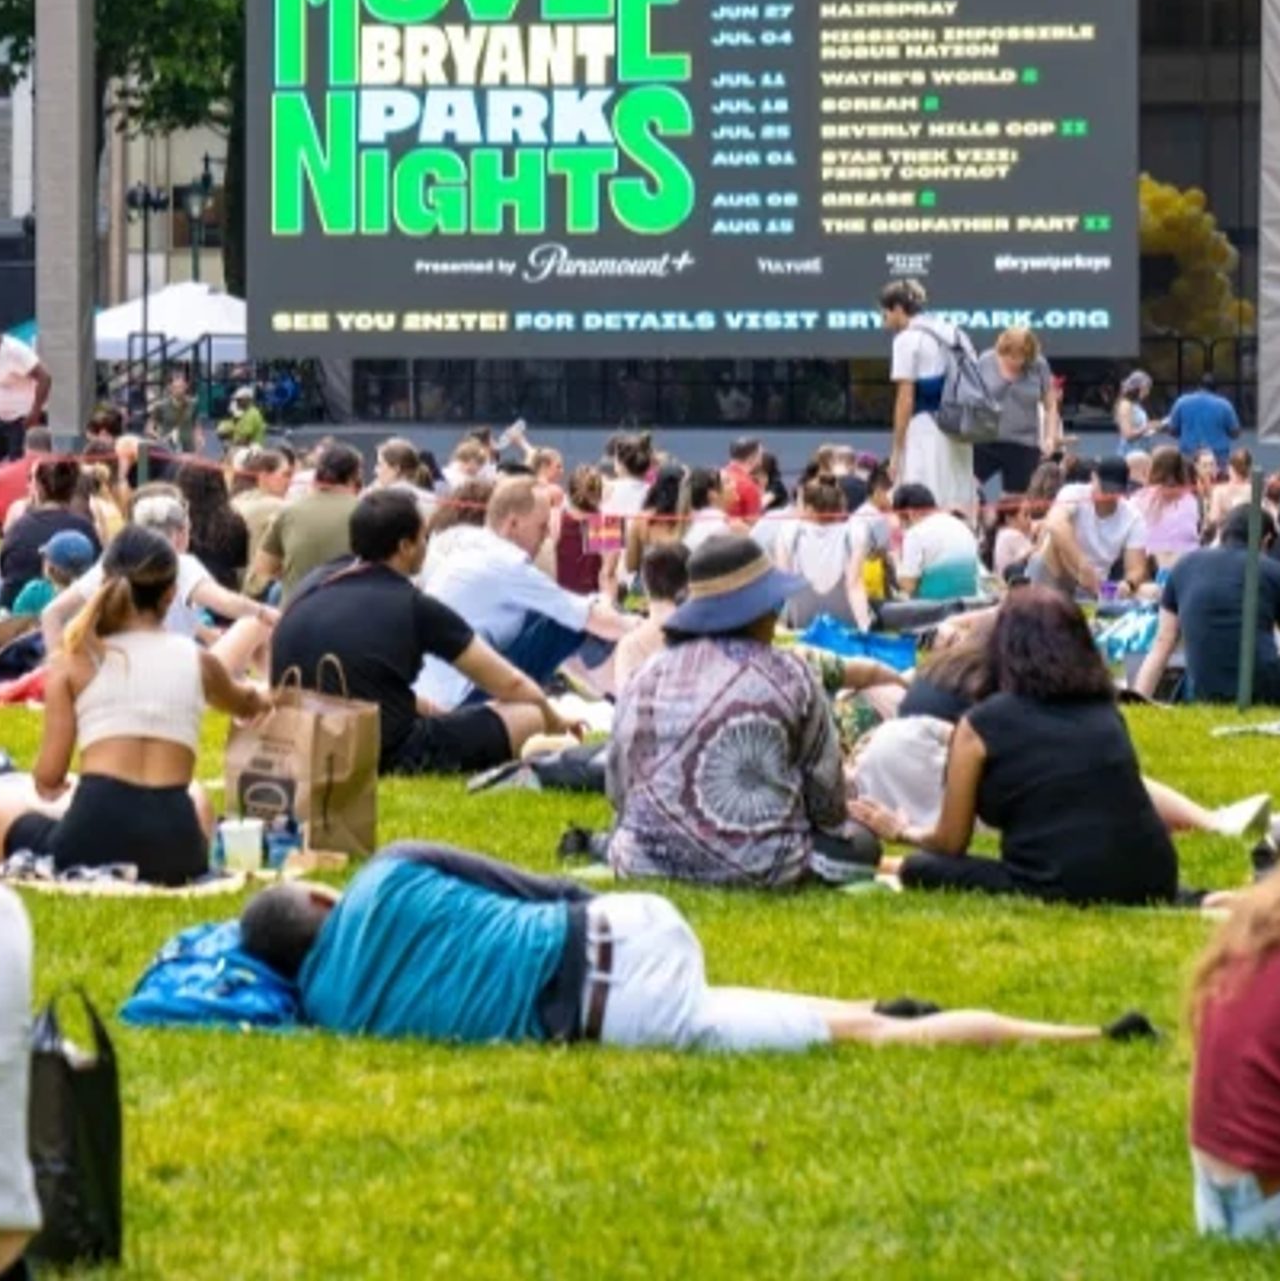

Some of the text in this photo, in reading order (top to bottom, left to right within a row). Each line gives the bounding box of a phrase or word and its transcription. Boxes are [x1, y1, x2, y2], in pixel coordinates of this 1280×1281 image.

[711, 4, 759, 19] JUN
[821, 1, 958, 18] HAIRSPRAY
[711, 31, 756, 47] JUL
[943, 25, 1096, 41] IMPOSSIBLE
[360, 24, 615, 86] BRYANT
[905, 44, 1000, 58] NATION
[711, 73, 756, 88] JUL
[930, 68, 1018, 84] WORLD
[711, 99, 756, 114] JUL
[821, 97, 919, 113] SCREAM
[359, 89, 613, 143] PARK
[711, 125, 756, 140] JUL
[821, 123, 922, 139] BEVERLY
[928, 122, 1000, 137] HILLS
[1004, 121, 1057, 137] COP
[271, 85, 695, 235] NIGHTS
[711, 151, 761, 166] AUG
[821, 150, 882, 165] STAR
[887, 149, 948, 164] TREK
[821, 164, 1010, 181] FIRST CONTACT
[711, 193, 761, 208] AUG
[821, 191, 916, 207] GREASE
[711, 219, 761, 234] AUG
[821, 218, 866, 233] THE
[872, 216, 1010, 232] GODFATHER
[1016, 215, 1078, 231] PART
[414, 259, 517, 275] Presented by
[272, 312, 329, 331] SEE
[336, 312, 396, 331] YOU
[515, 311, 576, 330] FOR
[582, 310, 716, 330] DETAILS
[725, 311, 818, 329] VISIT
